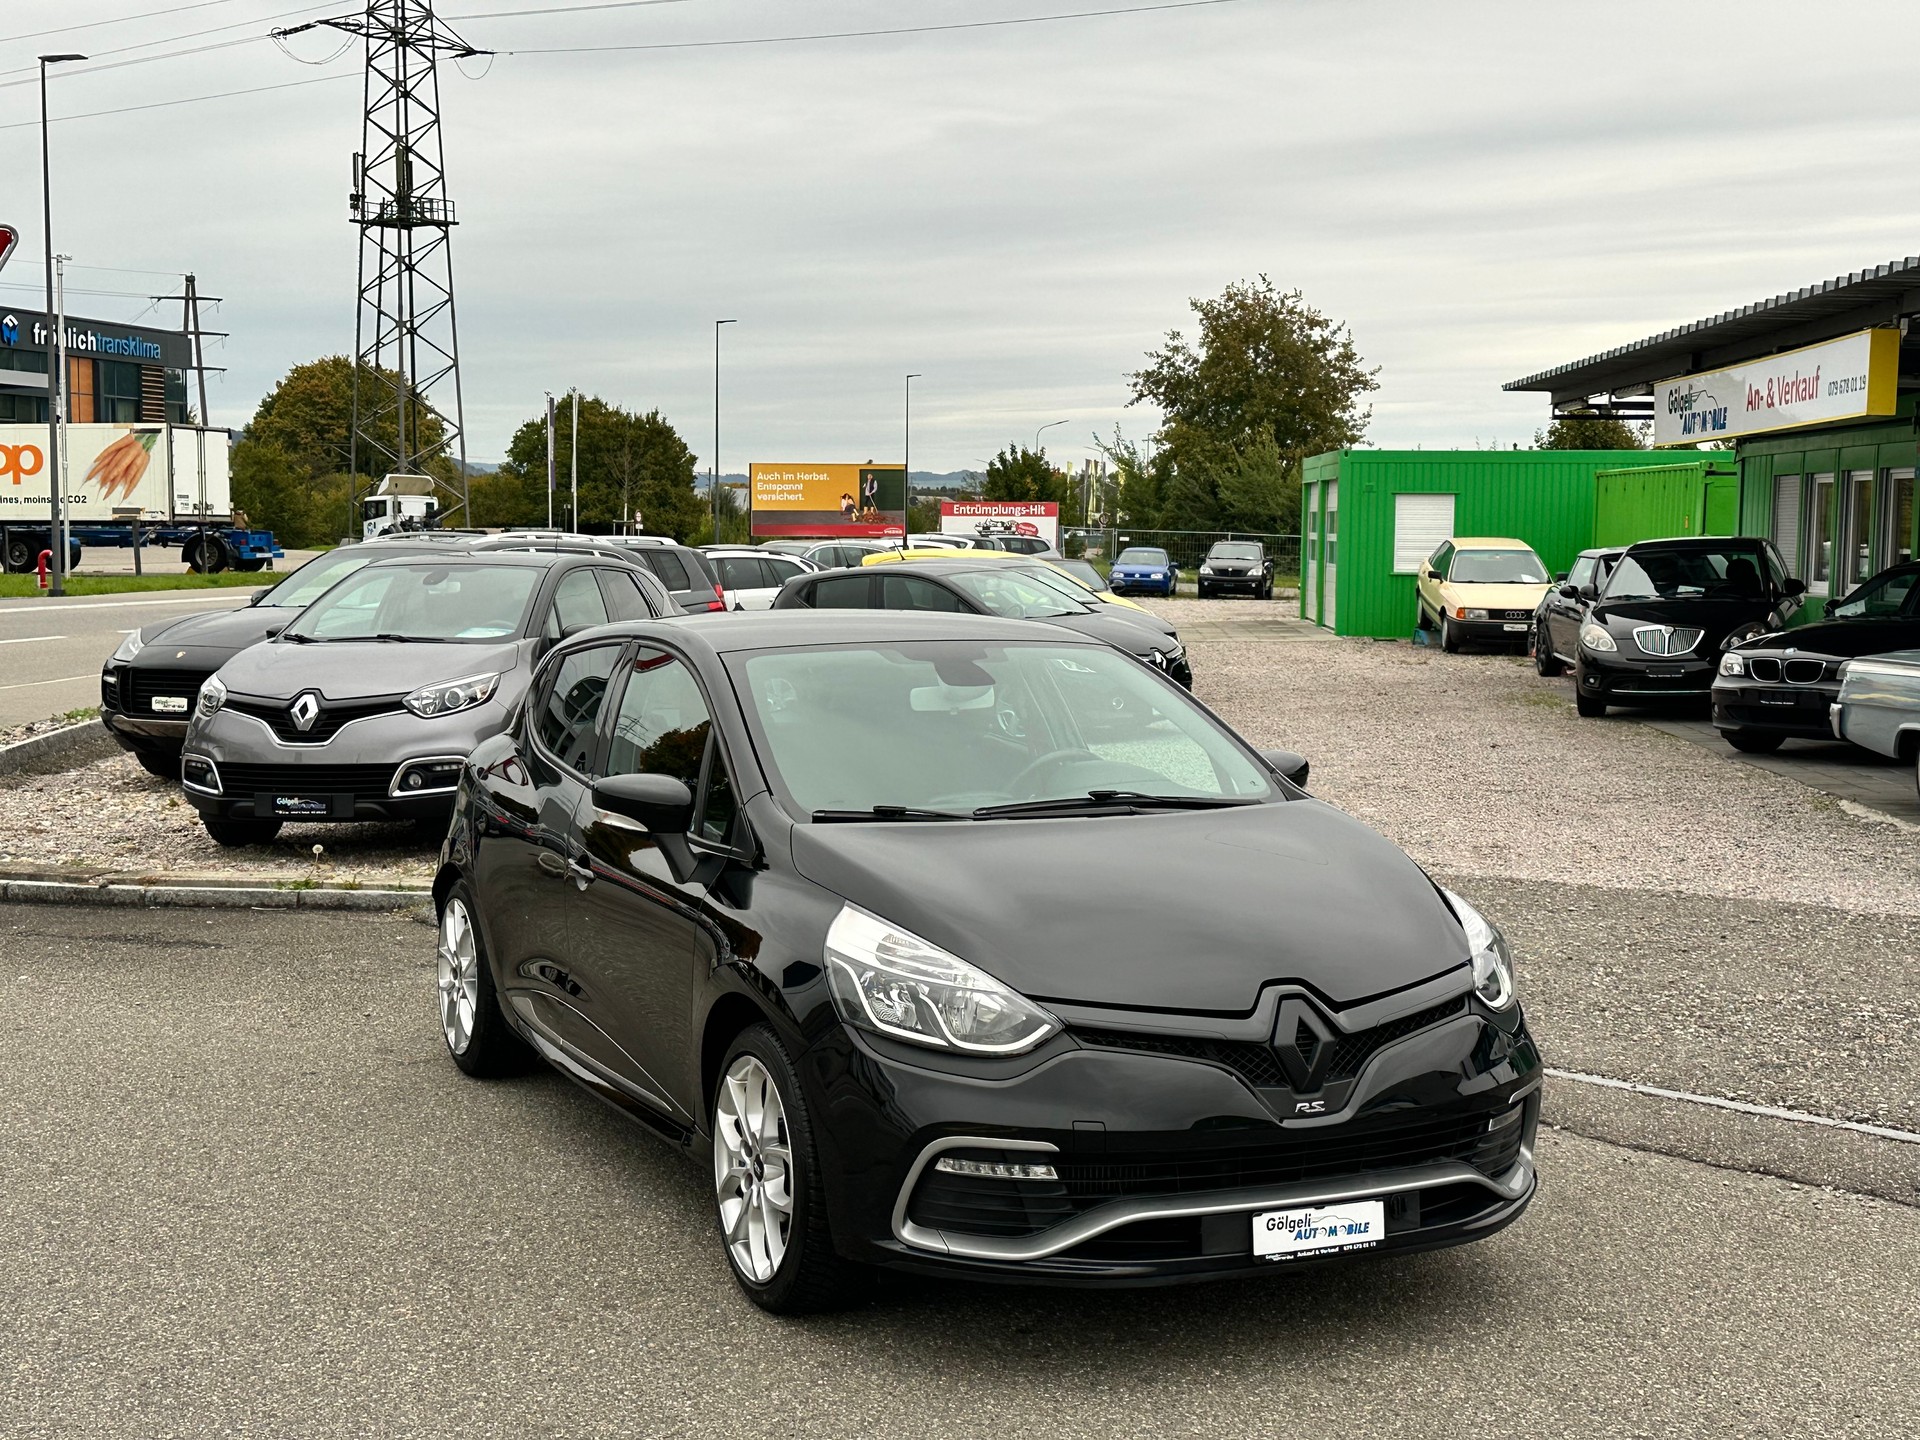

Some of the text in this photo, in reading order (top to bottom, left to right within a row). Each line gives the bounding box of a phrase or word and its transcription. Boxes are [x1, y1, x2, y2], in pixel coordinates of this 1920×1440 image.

[1746, 365, 1821, 412] An- & Verkauf
[1828, 380, 1838, 397] 079
[1850, 376, 1858, 392] 01
[1859, 374, 1867, 391] 19
[757, 471, 830, 481] Auch im Herbst.
[757, 482, 803, 495] Entspannt
[67, 494, 88, 504] CO2
[757, 491, 805, 501] versichert.
[953, 503, 1046, 516] Entrümplungs-Hit
[1294, 1100, 1326, 1113] RS
[1266, 1213, 1312, 1233] Gölgeli
[1294, 1221, 1370, 1241] AUTOMOBILE
